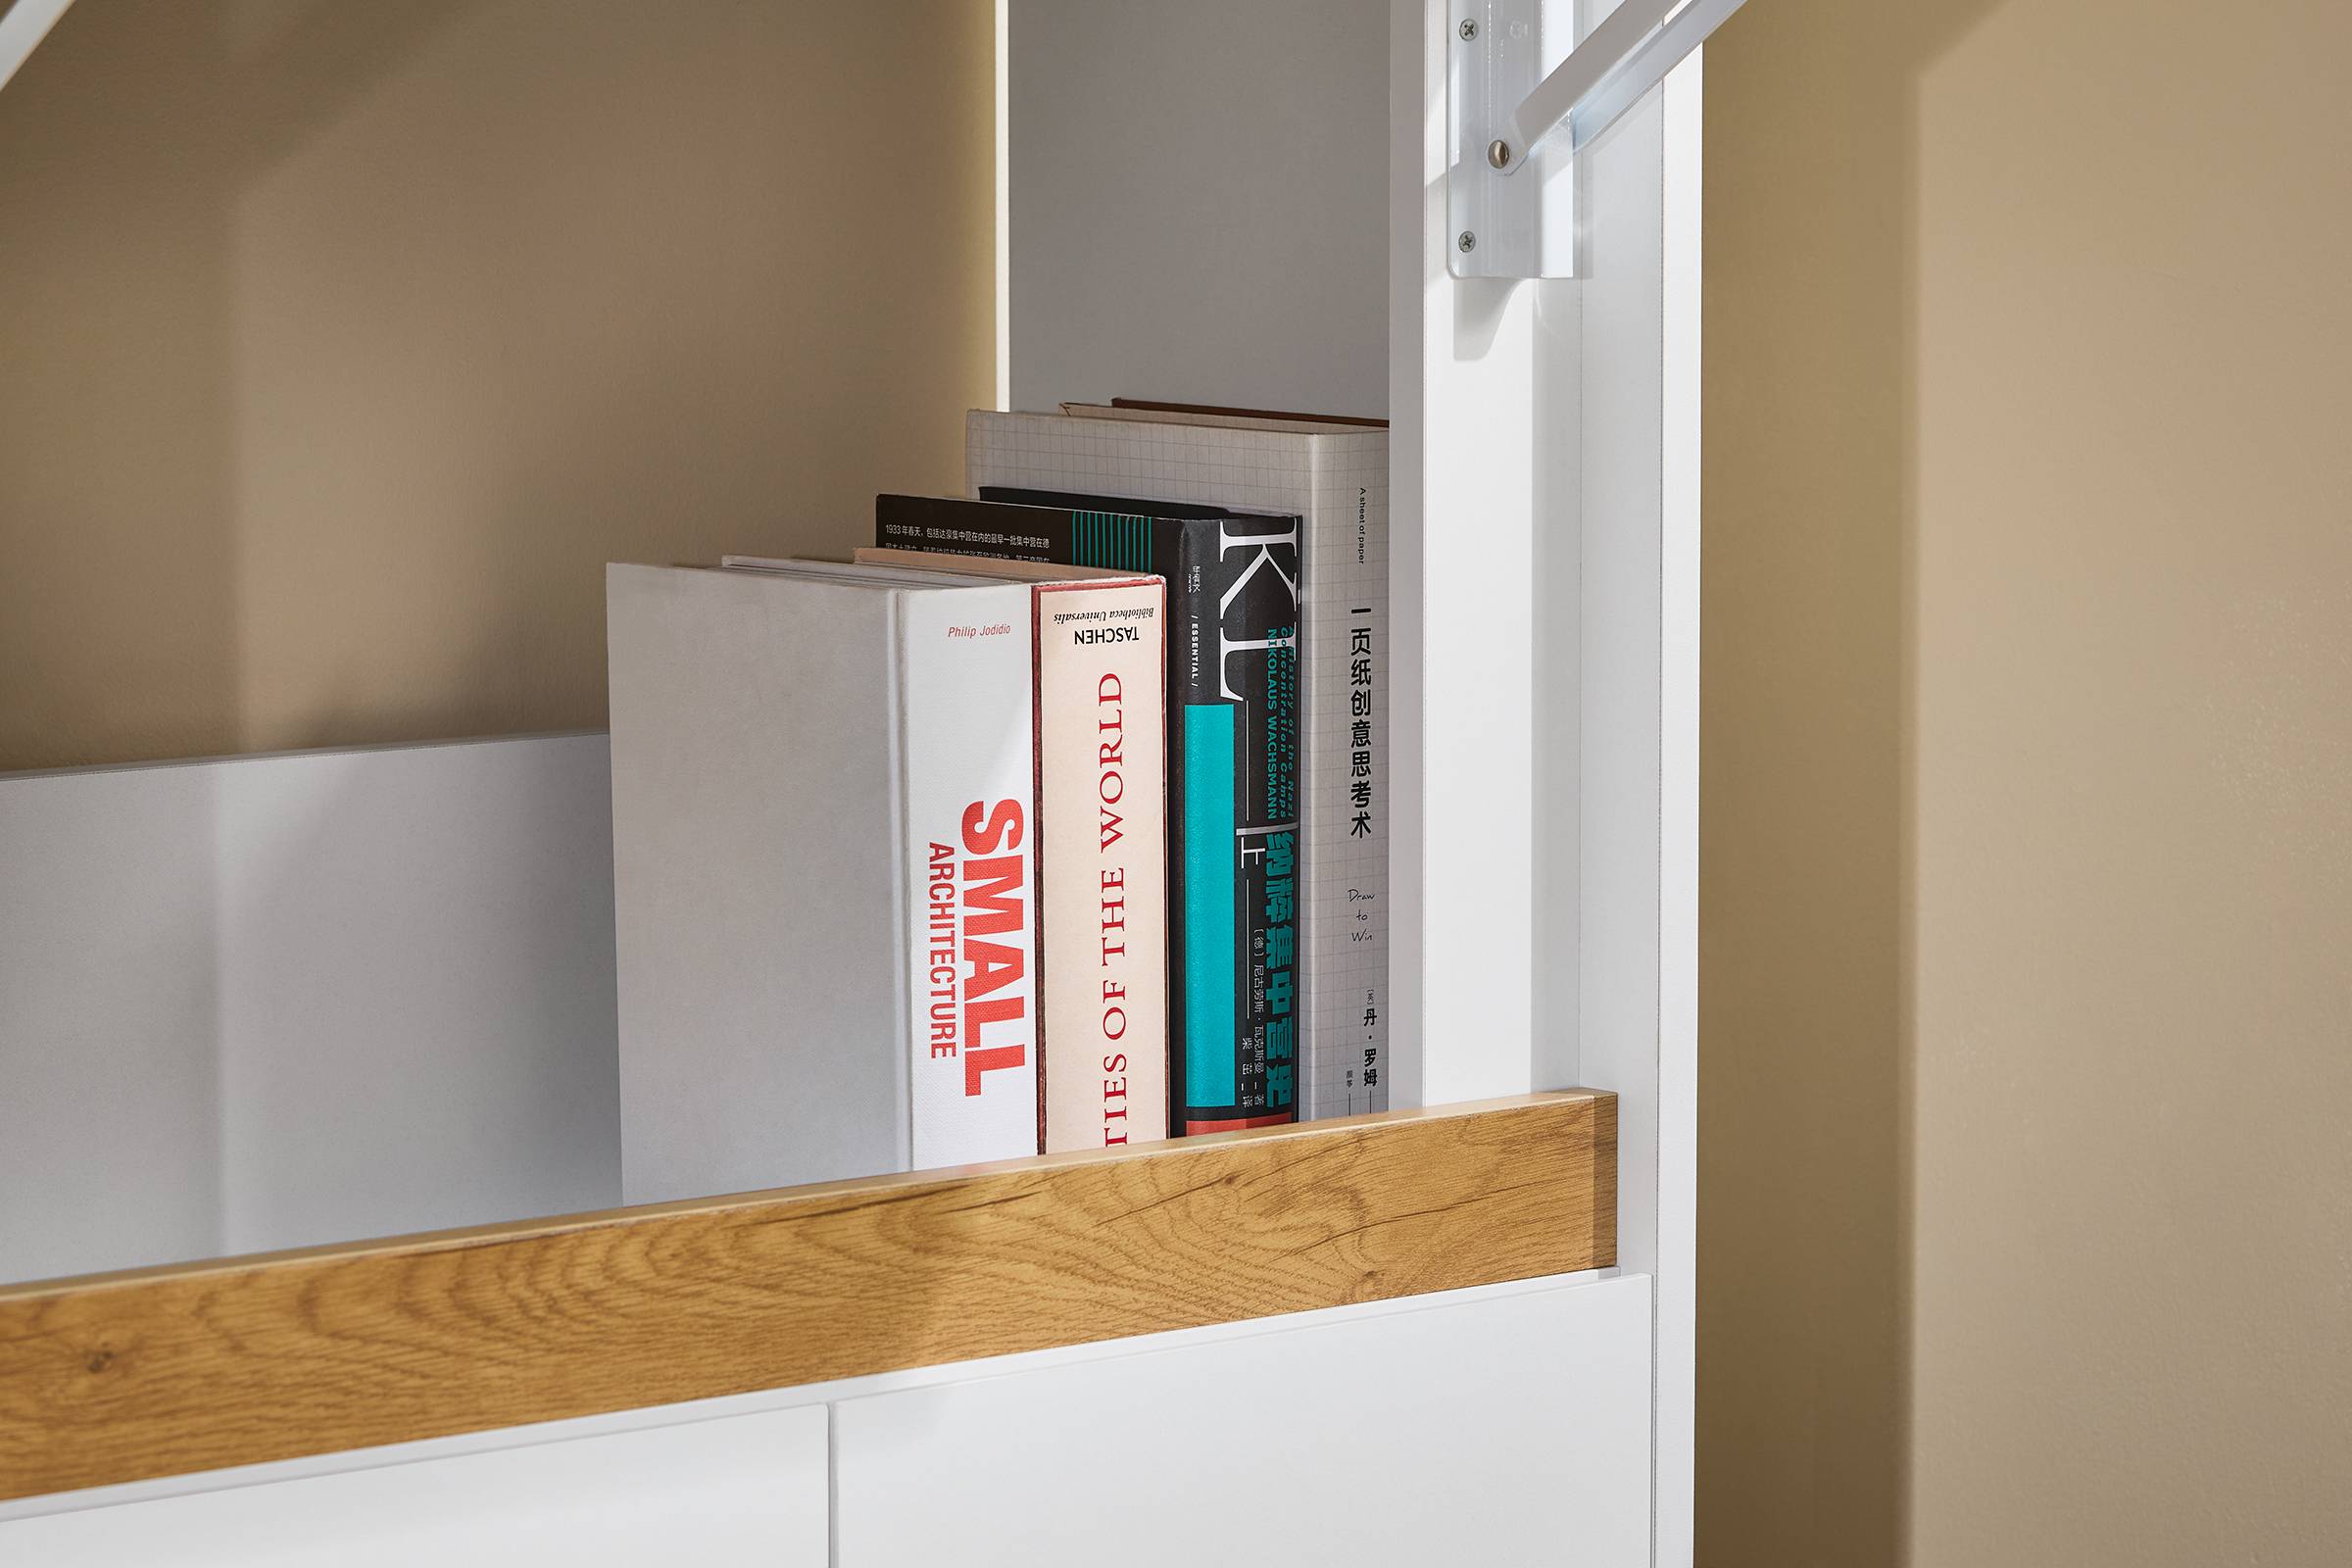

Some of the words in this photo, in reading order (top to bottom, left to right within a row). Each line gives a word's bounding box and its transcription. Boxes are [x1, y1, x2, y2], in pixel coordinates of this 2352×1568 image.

[1359, 487, 1367, 496] A
[1358, 525, 1366, 535] of
[948, 626, 977, 639] Philip
[979, 623, 1011, 636] Jodidio
[1054, 610, 1106, 622] Universalis
[1074, 625, 1140, 646] TASCHEN
[1109, 607, 1154, 618] Bibliotheca
[1267, 628, 1277, 710] NIKOLAUS
[1350, 607, 1372, 839] 一页纸创意思考术
[1099, 672, 1125, 854] WORLD
[1267, 716, 1277, 819] WACHSMANN
[1279, 761, 1288, 818] Camps
[1102, 866, 1126, 966] THE
[1348, 888, 1375, 903] Draw
[1355, 911, 1368, 921] to
[928, 841, 956, 1059] ARCHITECTURE
[961, 798, 1026, 1097] SMALL
[1351, 931, 1373, 942] Win
[1265, 831, 1295, 1108] 纳粹集中营史
[1102, 979, 1127, 1041] OF
